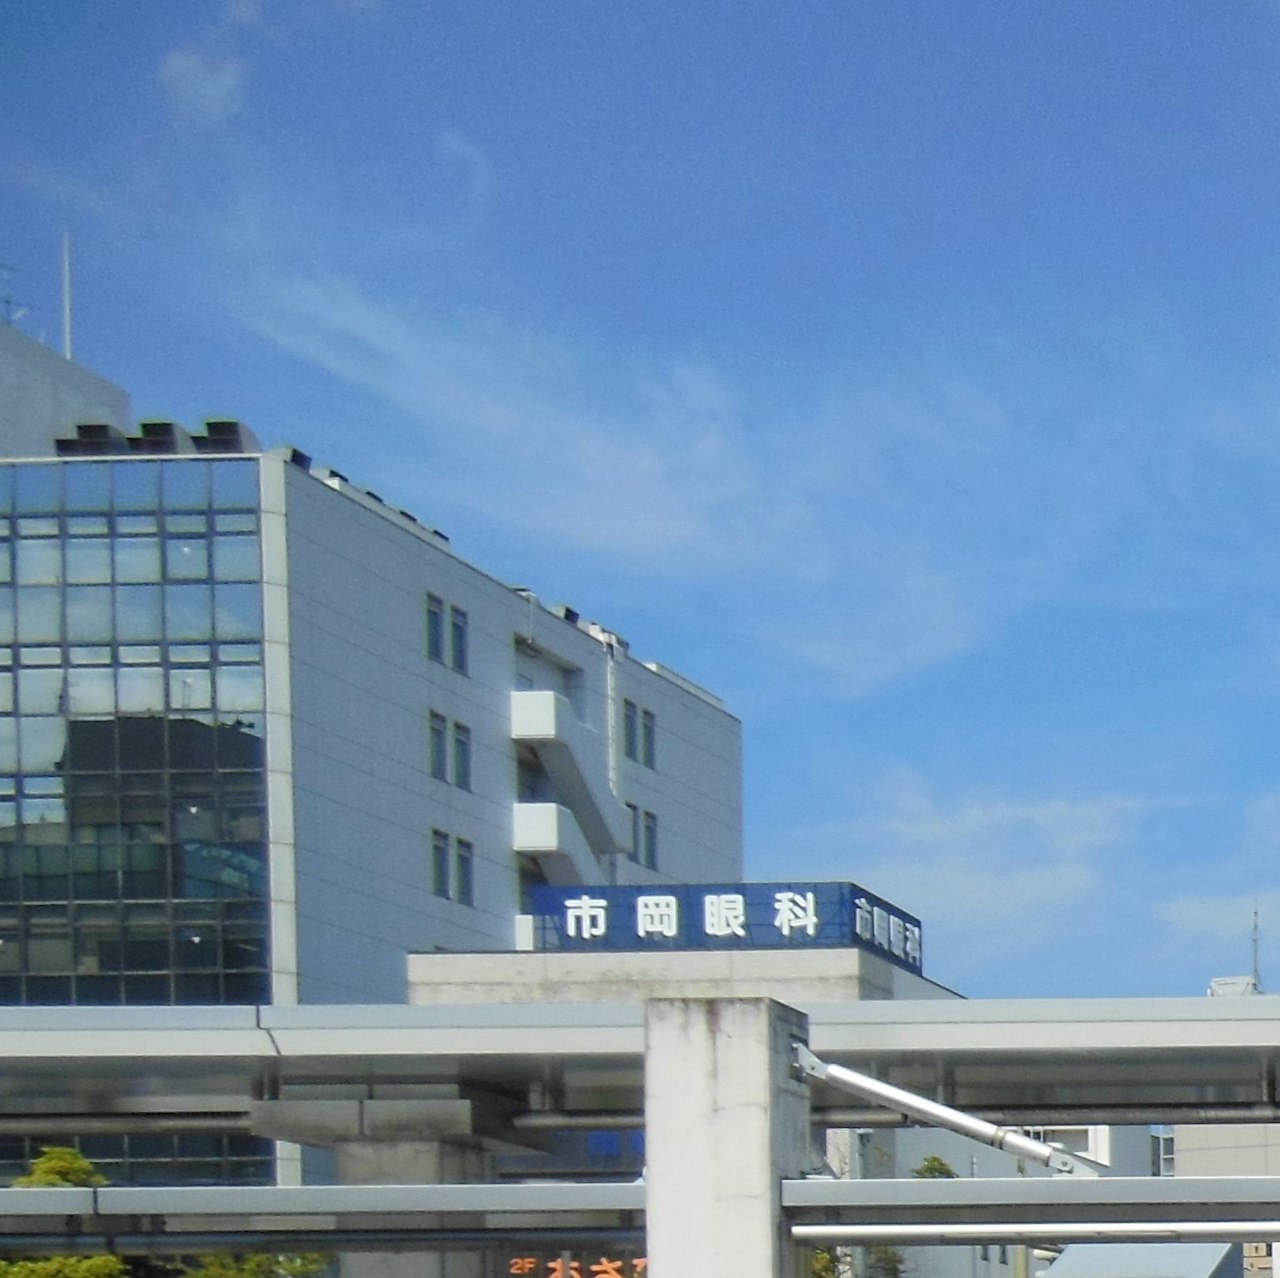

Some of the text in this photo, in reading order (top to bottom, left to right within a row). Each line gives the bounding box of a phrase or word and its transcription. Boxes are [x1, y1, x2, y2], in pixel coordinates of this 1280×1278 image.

[564, 891, 819, 940] 市岡眼科
[509, 1257, 538, 1274] 2F
